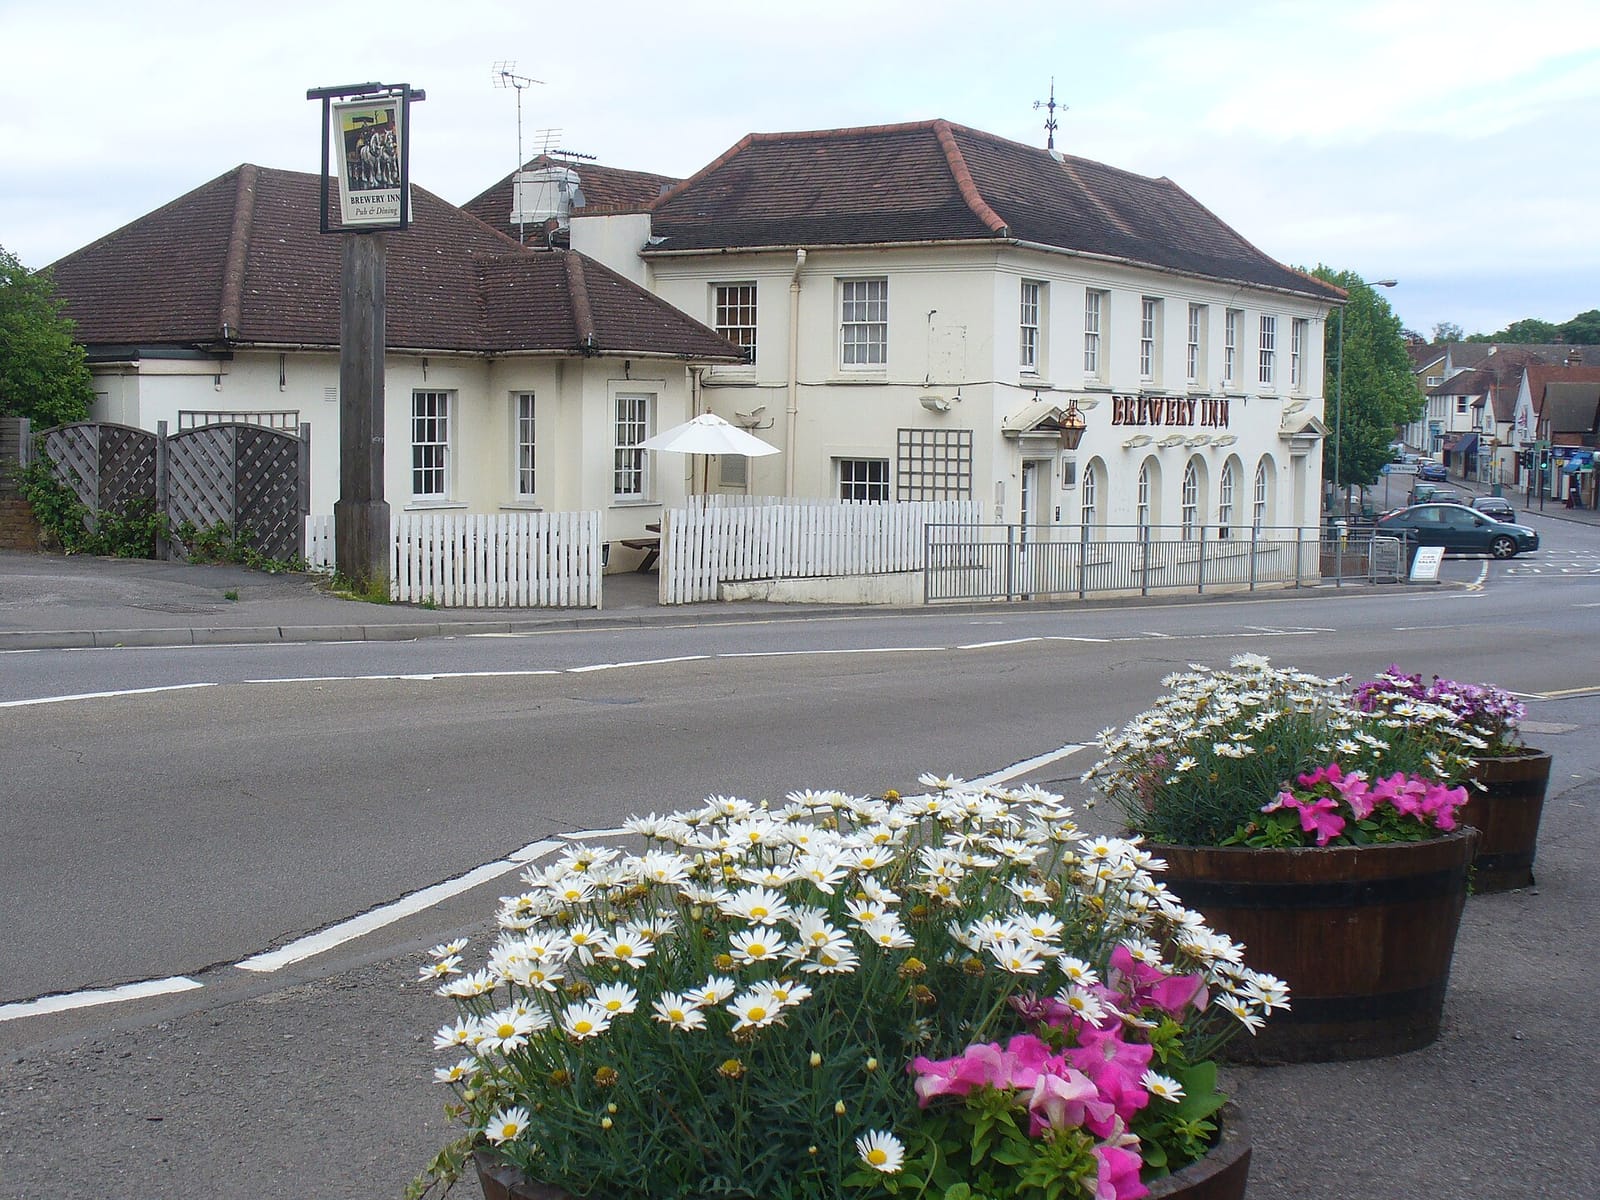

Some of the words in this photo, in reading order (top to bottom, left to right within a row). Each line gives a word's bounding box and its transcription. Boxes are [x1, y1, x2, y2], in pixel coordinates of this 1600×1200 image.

[351, 195, 384, 204] BREWERY
[387, 194, 401, 202] INN
[356, 207, 367, 215] Pub
[369, 206, 375, 215] &
[376, 207, 397, 216] Dining
[1112, 396, 1197, 426] BREWERY
[1201, 399, 1229, 429] INN
